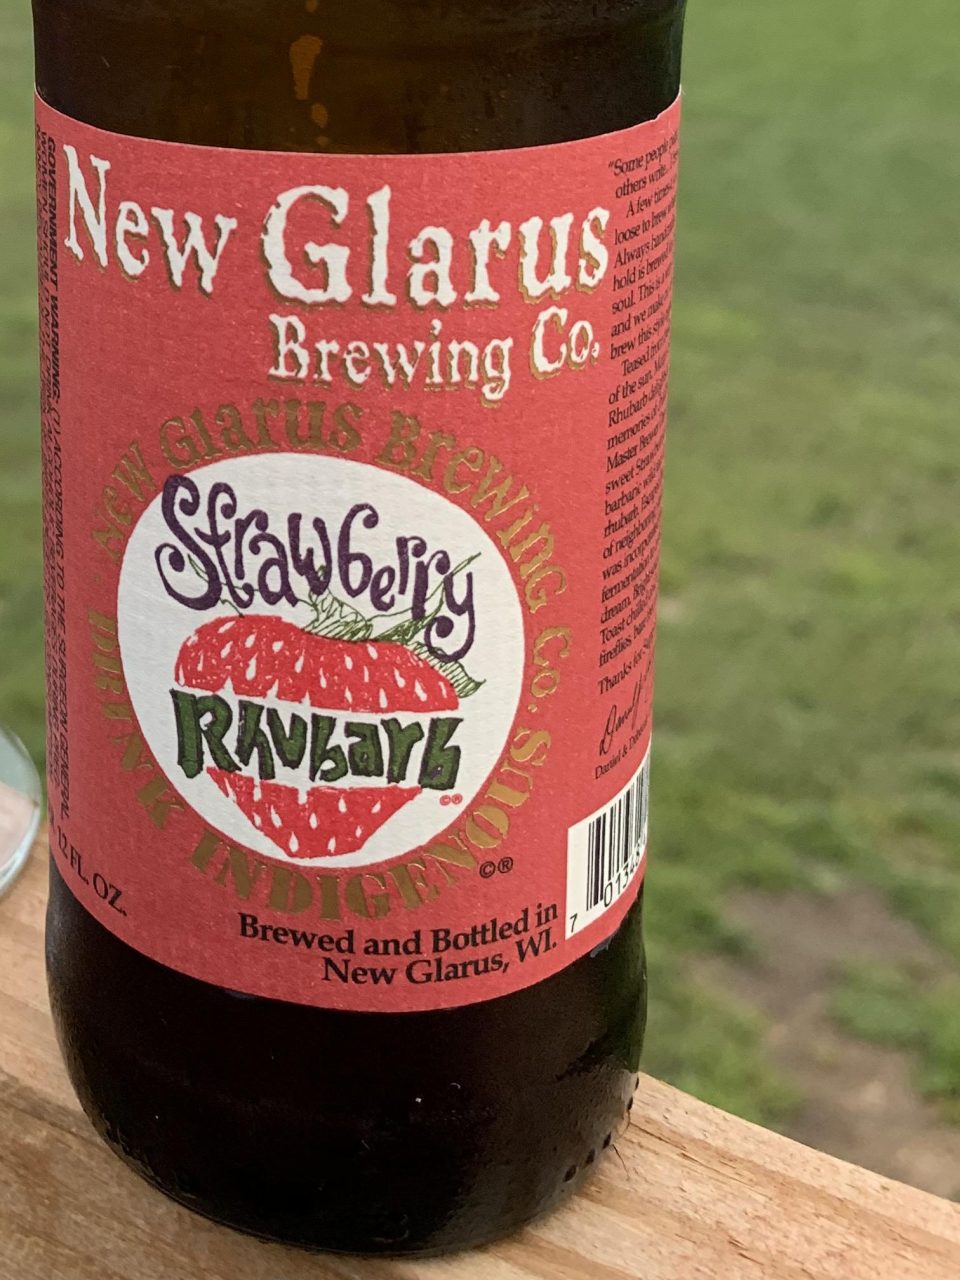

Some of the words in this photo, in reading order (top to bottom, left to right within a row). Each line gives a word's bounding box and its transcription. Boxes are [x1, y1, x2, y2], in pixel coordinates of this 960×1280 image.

[615, 176, 647, 199] others
[48, 136, 58, 290] GOVERNMENT
[626, 200, 635, 218] A
[636, 195, 653, 215] few
[62, 143, 238, 297] New
[260, 183, 611, 309] Glarus
[614, 224, 641, 246] loose
[642, 218, 651, 234] to
[614, 240, 651, 269] Always
[613, 267, 636, 292] hold
[638, 265, 646, 281] is
[638, 280, 655, 302] This
[610, 313, 631, 337] and
[633, 309, 647, 326] we
[50, 294, 60, 404] WARNING:
[267, 314, 515, 404] Brewing
[531, 305, 600, 380] Co.
[610, 338, 636, 360] brew
[621, 345, 650, 377] Teased
[608, 384, 621, 405] of
[622, 380, 637, 399] the
[608, 391, 648, 428] Rhubarb
[606, 444, 639, 473] Master
[605, 467, 635, 495] sweet
[53, 437, 64, 560] ACCORDING
[602, 539, 615, 559] of
[56, 563, 65, 590] TO
[154, 474, 476, 663] Strawberry
[602, 560, 623, 581] was
[57, 594, 66, 634] THE
[599, 618, 626, 645] Toast
[598, 661, 632, 695] Thanks
[61, 734, 69, 821] GENERAL
[192, 726, 551, 920] INDIGENOUS
[238, 911, 356, 955] Brewed
[363, 929, 423, 956] and
[430, 907, 531, 954] Bottled
[535, 902, 559, 928] in
[569, 912, 578, 933] 7
[321, 956, 398, 985] New
[405, 952, 511, 985] Glarus,
[515, 927, 558, 963] WI.
